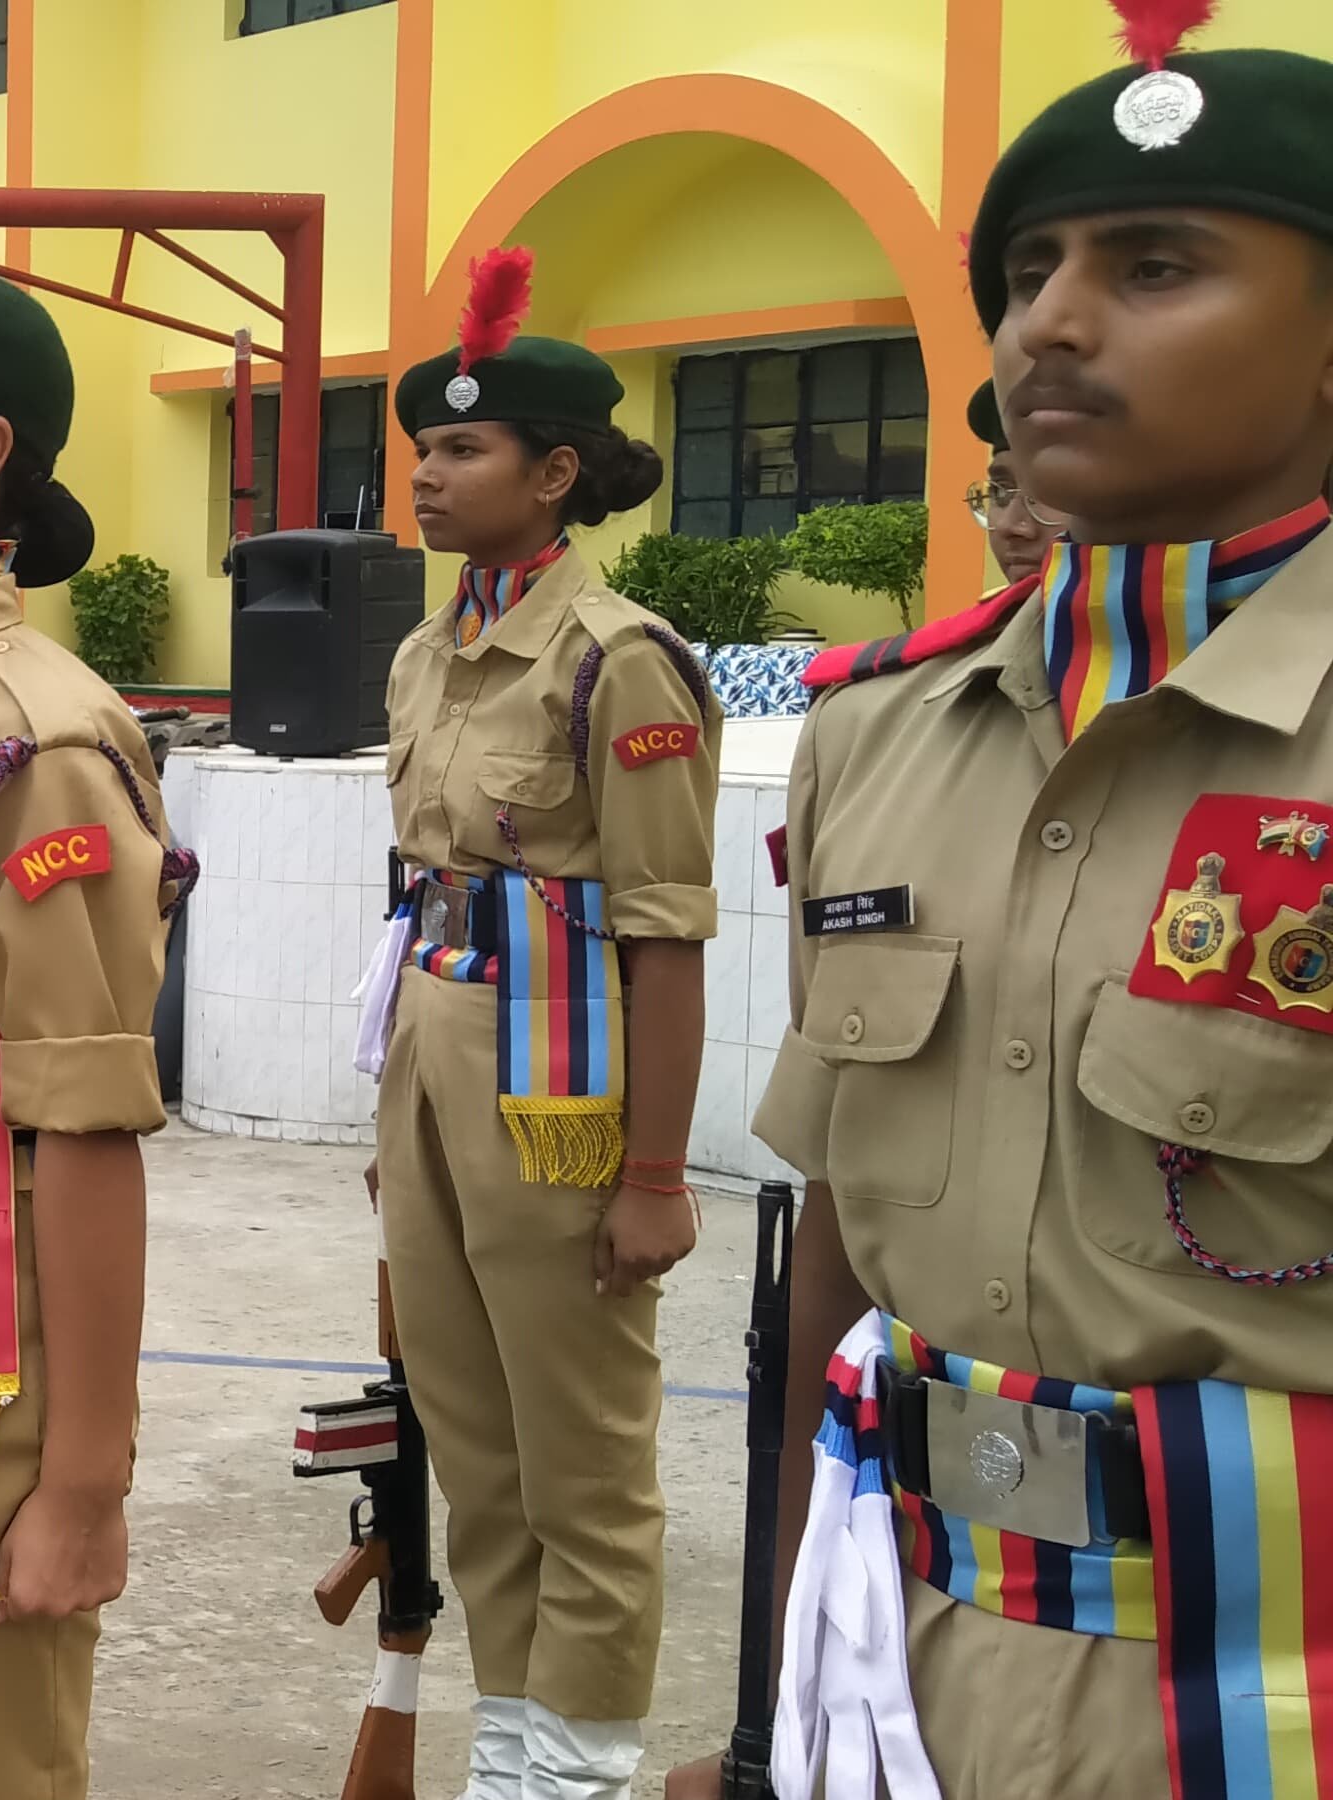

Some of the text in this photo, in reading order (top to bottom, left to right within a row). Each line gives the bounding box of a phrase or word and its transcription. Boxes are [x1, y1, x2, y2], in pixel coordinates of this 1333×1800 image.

[628, 730, 684, 758] NCC
[20, 835, 91, 885] NCC
[821, 911, 886, 931] AKASH SINGH
[1175, 902, 1222, 924] NATIONAL
